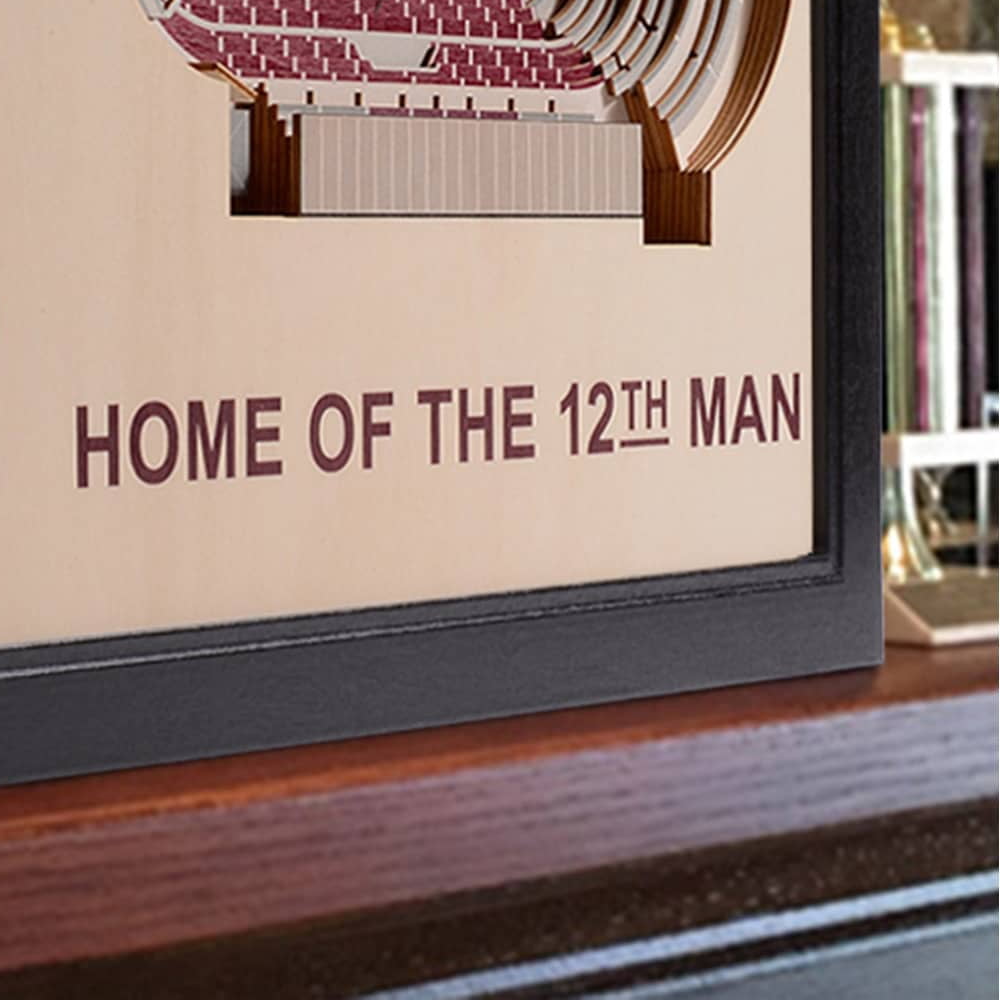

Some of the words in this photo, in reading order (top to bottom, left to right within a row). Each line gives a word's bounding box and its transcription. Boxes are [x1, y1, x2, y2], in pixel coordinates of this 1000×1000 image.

[75, 396, 283, 489] HOME
[309, 391, 394, 473] OF
[417, 384, 535, 465] THE
[559, 379, 670, 456] 12TH
[690, 372, 801, 448] MAN
